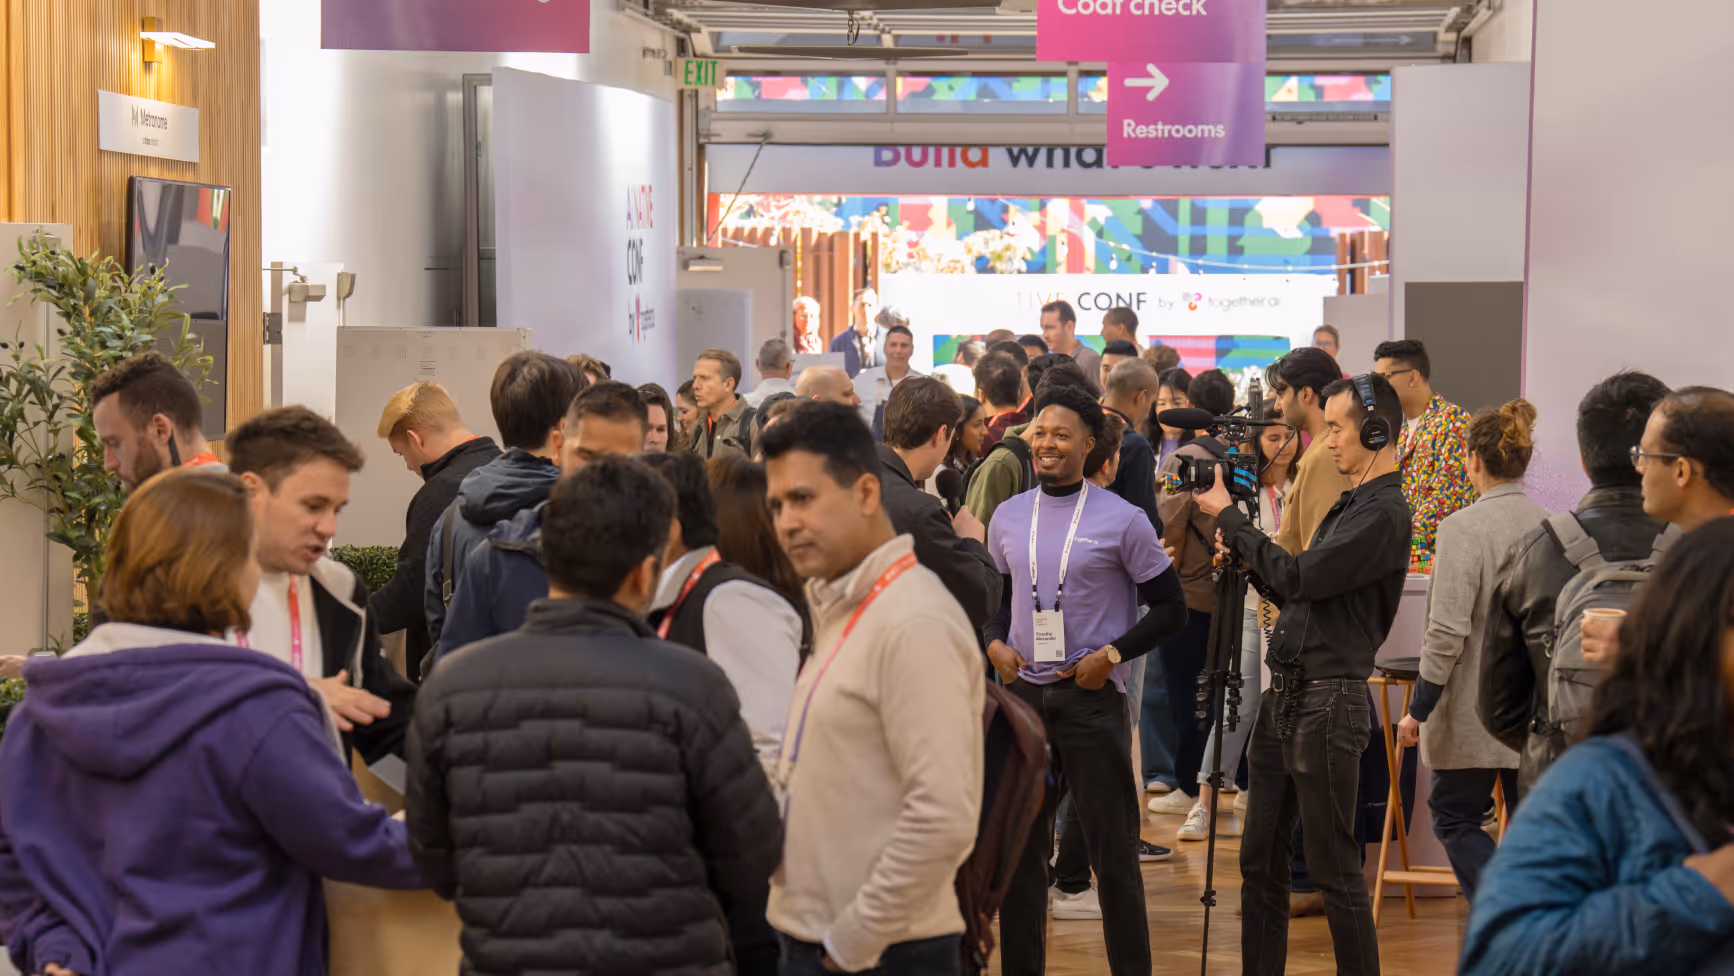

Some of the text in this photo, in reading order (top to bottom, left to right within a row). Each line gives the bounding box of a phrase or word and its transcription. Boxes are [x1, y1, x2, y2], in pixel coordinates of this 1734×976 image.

[1129, 0, 1207, 15] check
[684, 60, 718, 85] EXIT
[140, 108, 167, 130] Metronome
[1122, 119, 1225, 138] Restrooms
[627, 238, 643, 285] CONF
[1078, 292, 1147, 310] CONF
